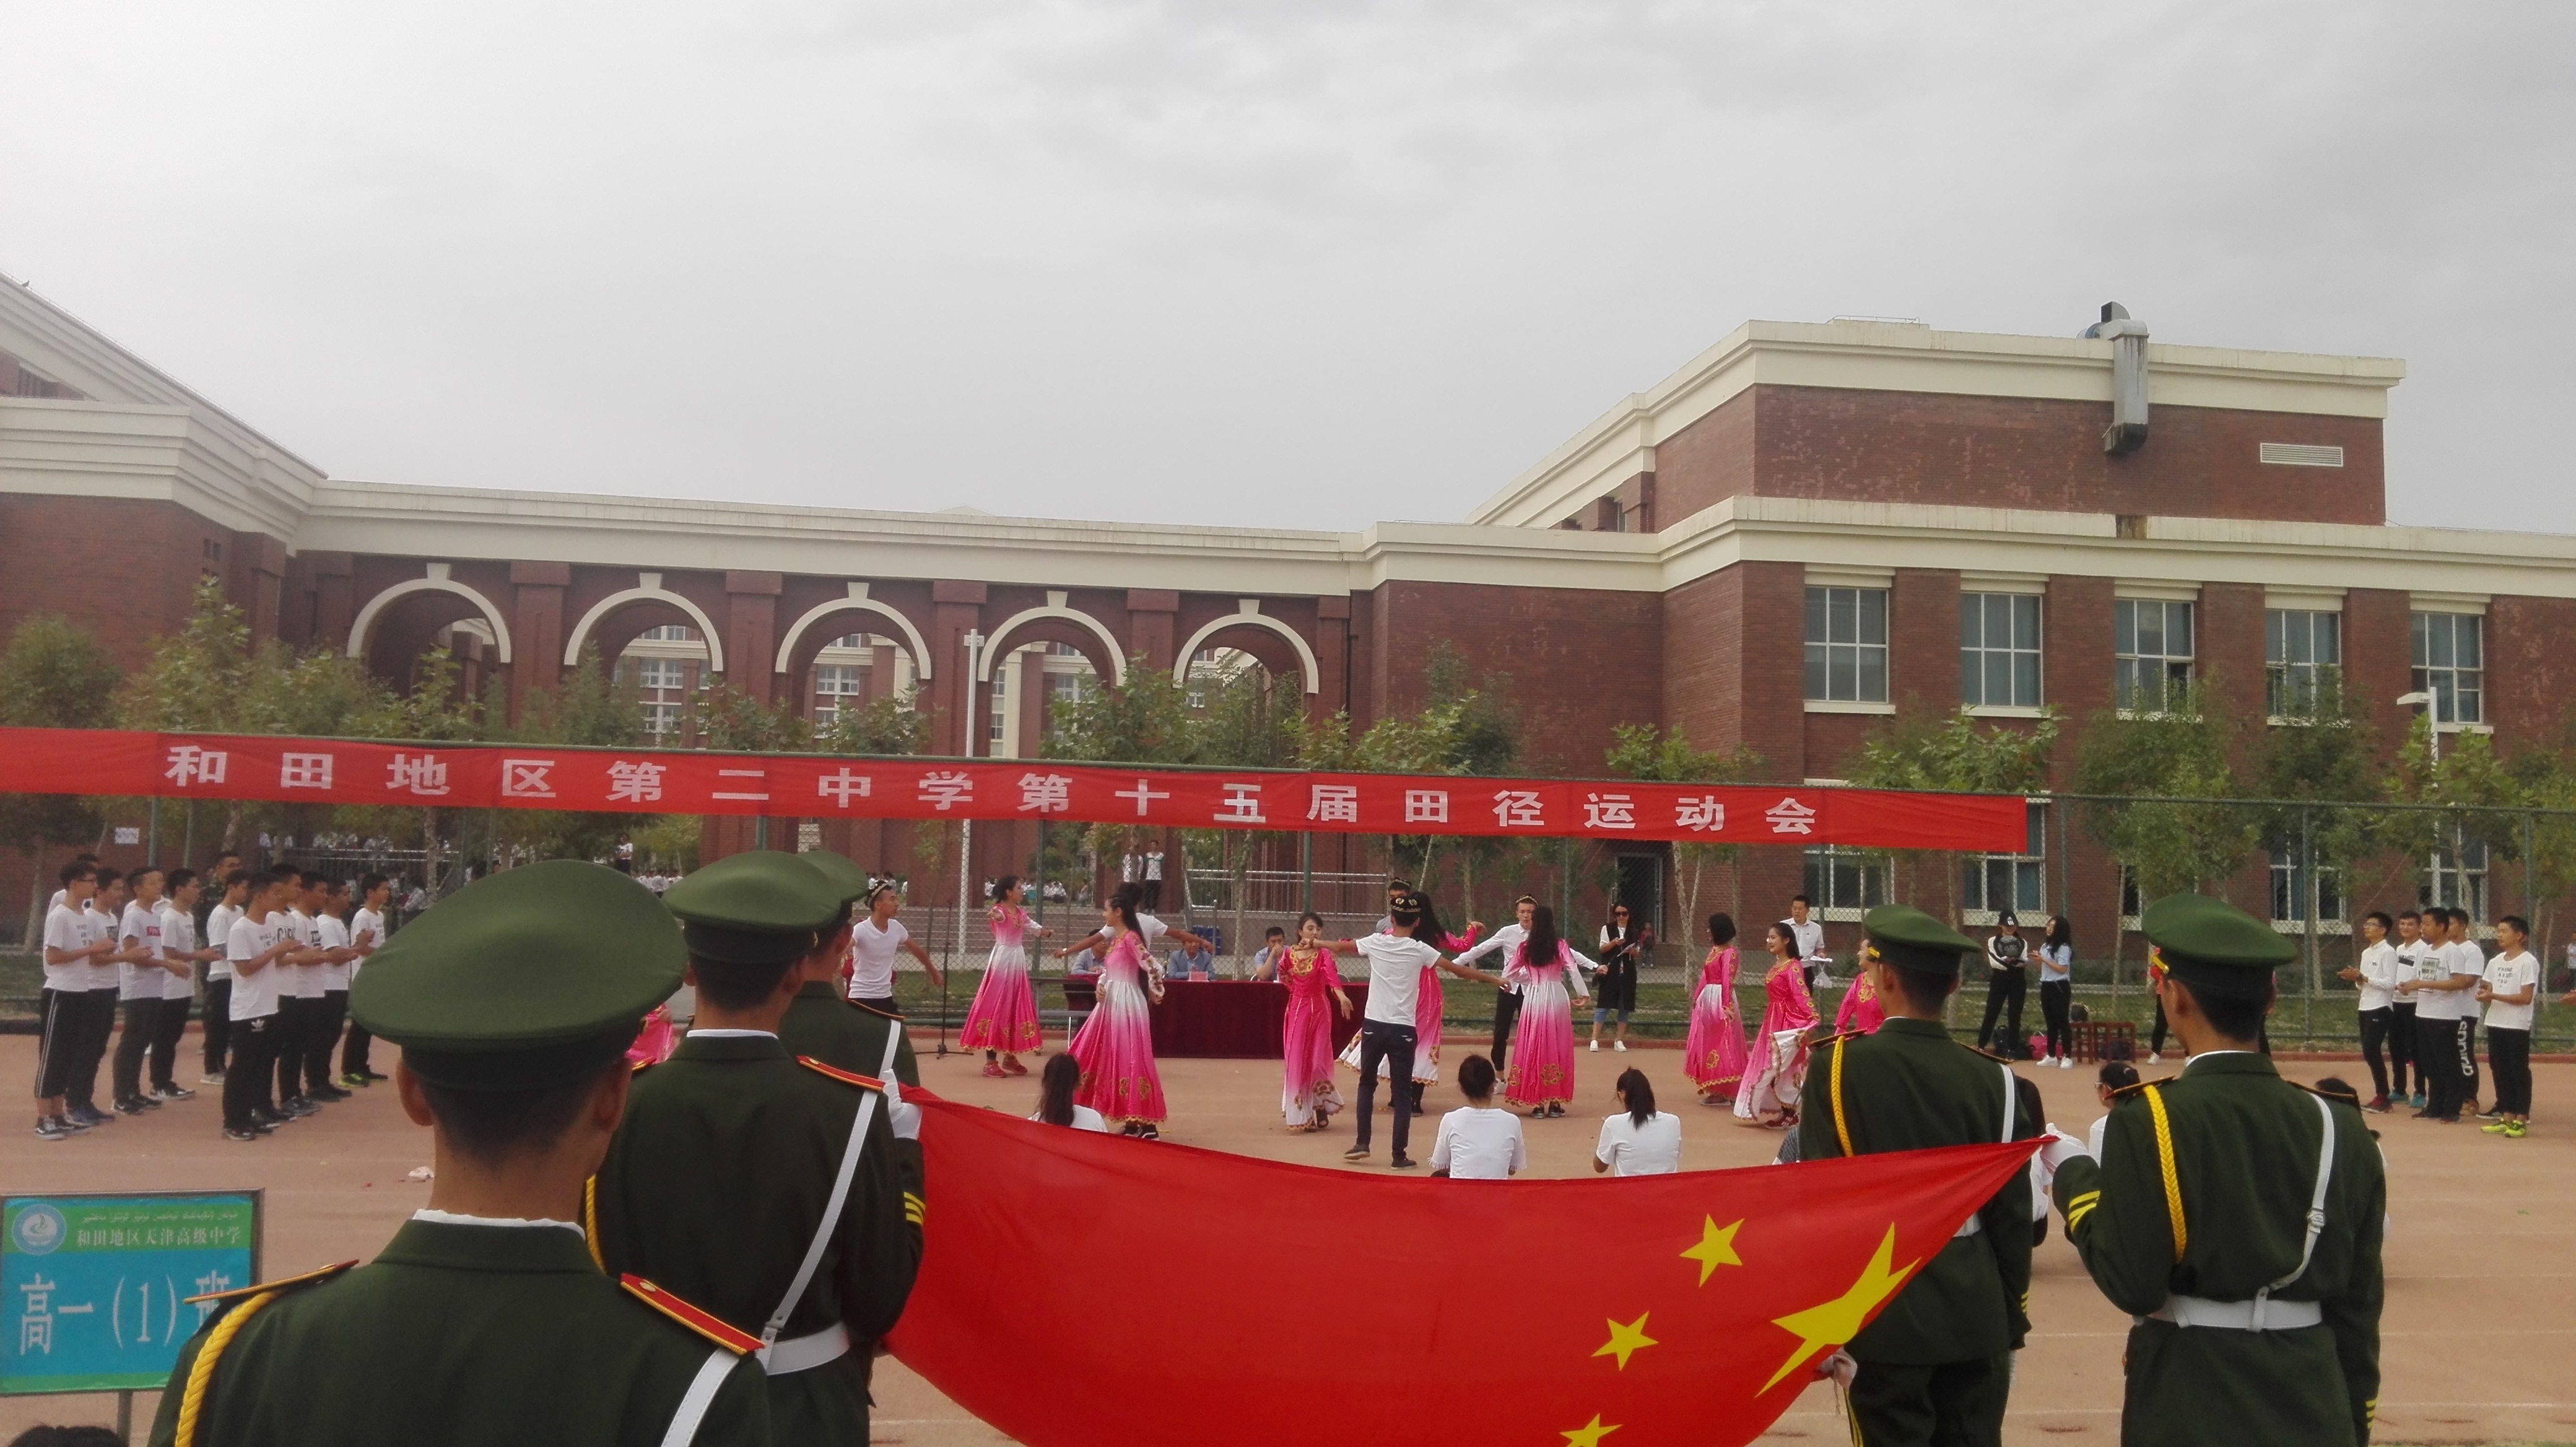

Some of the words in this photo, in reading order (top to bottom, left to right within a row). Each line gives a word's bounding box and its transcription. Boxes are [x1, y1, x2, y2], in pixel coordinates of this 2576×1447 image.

[165, 745, 1817, 836] 和田地区第二中学第十五届田径运动会
